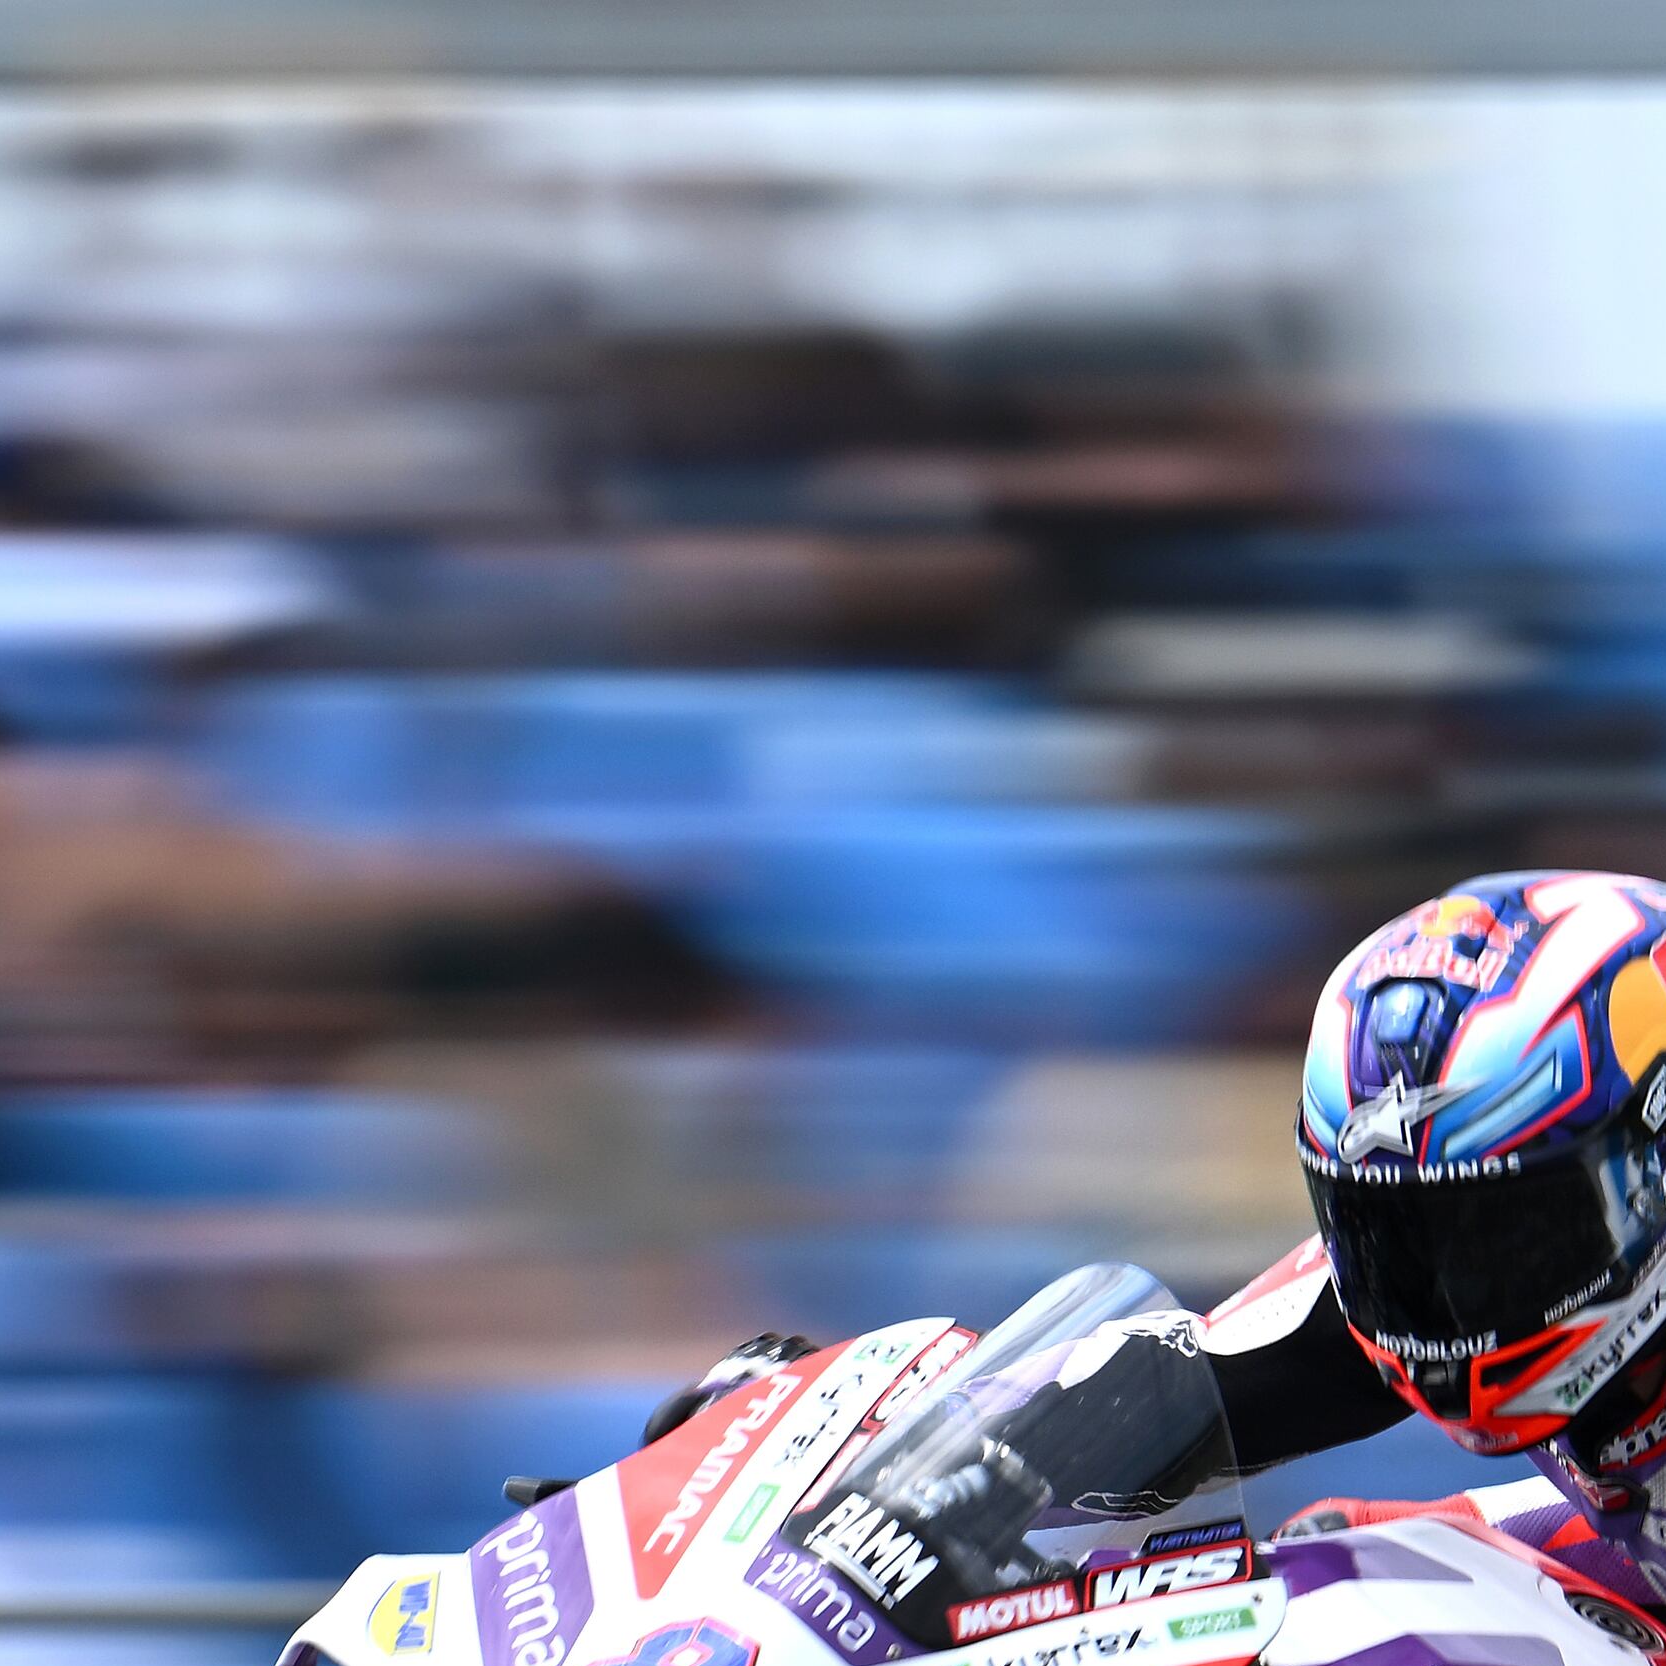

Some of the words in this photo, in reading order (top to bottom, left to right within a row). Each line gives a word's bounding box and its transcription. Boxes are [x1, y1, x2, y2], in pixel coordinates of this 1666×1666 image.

[1352, 1162, 1401, 1185] YOU
[1417, 1151, 1521, 1184] WINGS
[644, 1372, 803, 1555] PRAMAC
[752, 1551, 876, 1655] prima
[1094, 1545, 1244, 1609] WRS
[956, 1582, 1075, 1641] MOTUL
